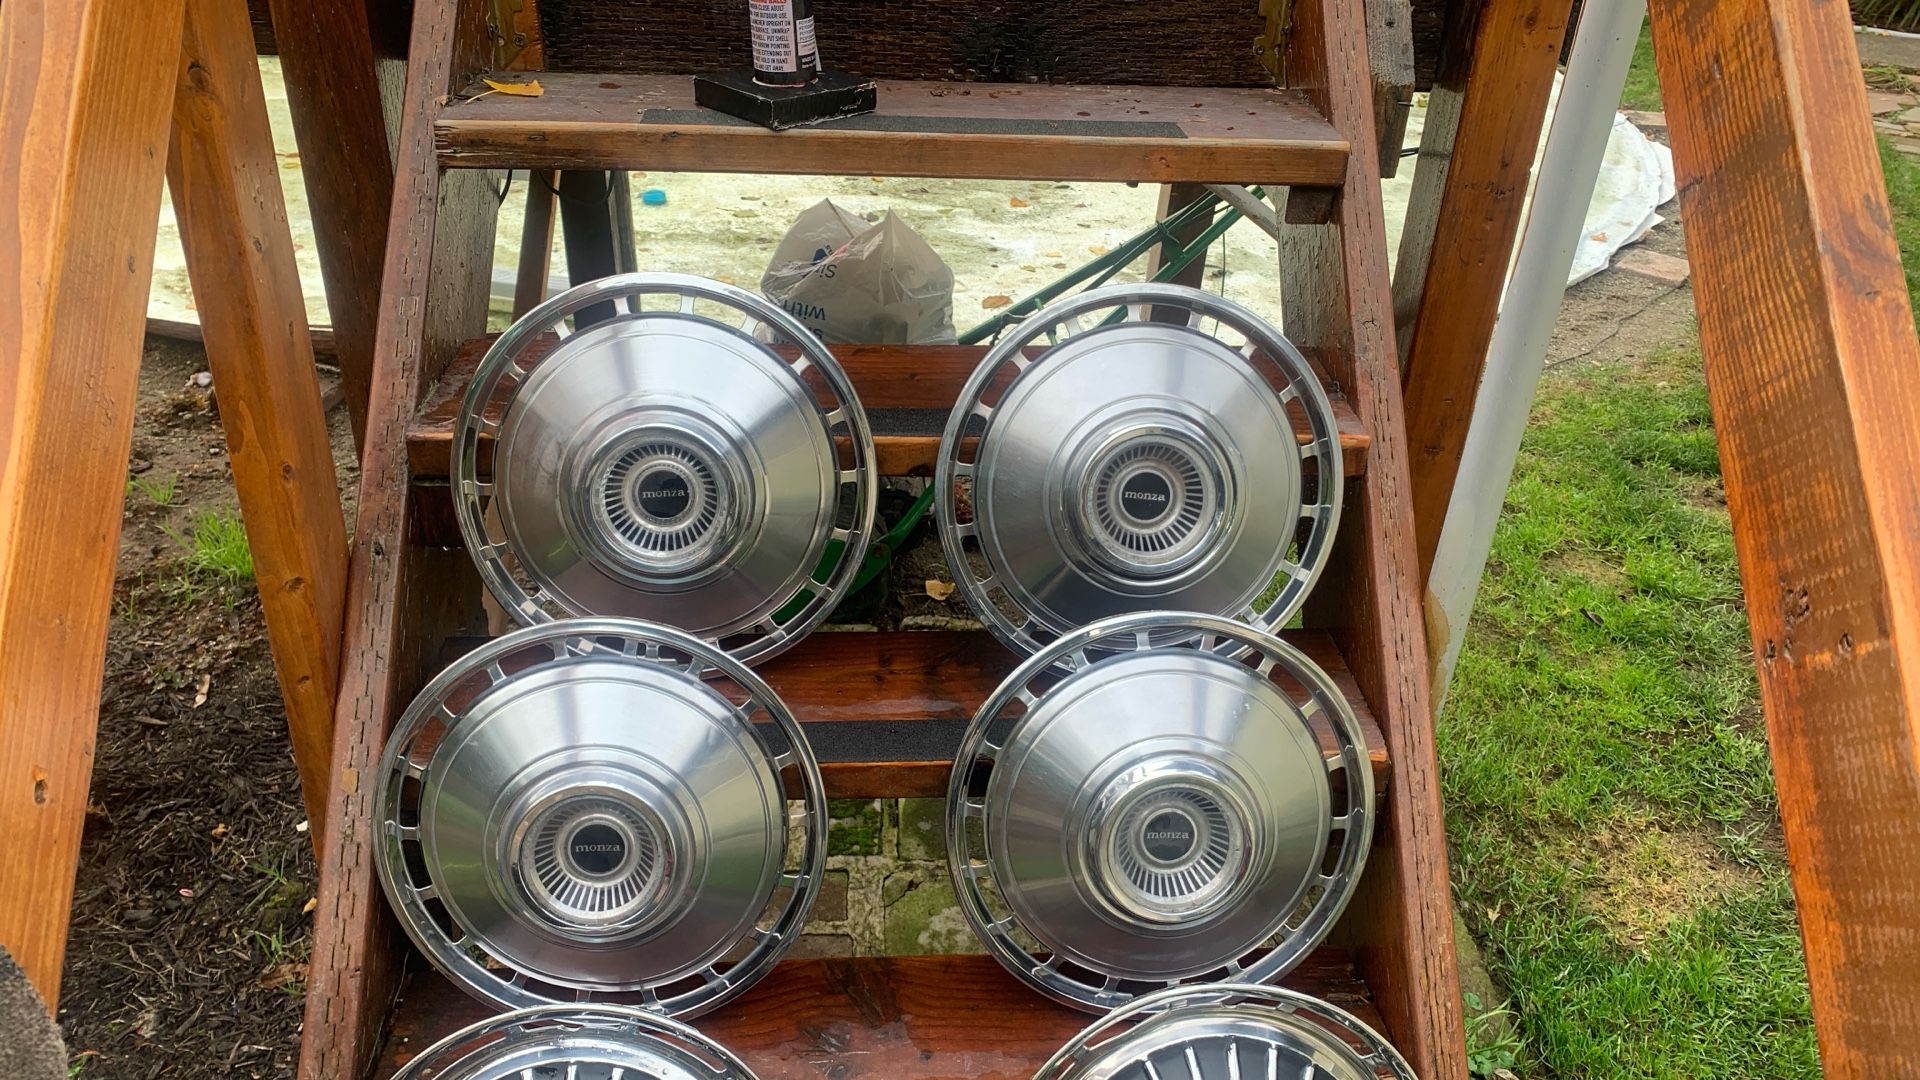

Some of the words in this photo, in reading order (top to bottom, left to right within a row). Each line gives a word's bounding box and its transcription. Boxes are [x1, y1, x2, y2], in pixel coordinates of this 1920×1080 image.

[783, 300, 826, 321] with
[642, 489, 686, 498] monza
[1124, 490, 1166, 501] monza
[1146, 830, 1190, 840] monza
[575, 843, 622, 852] monza
